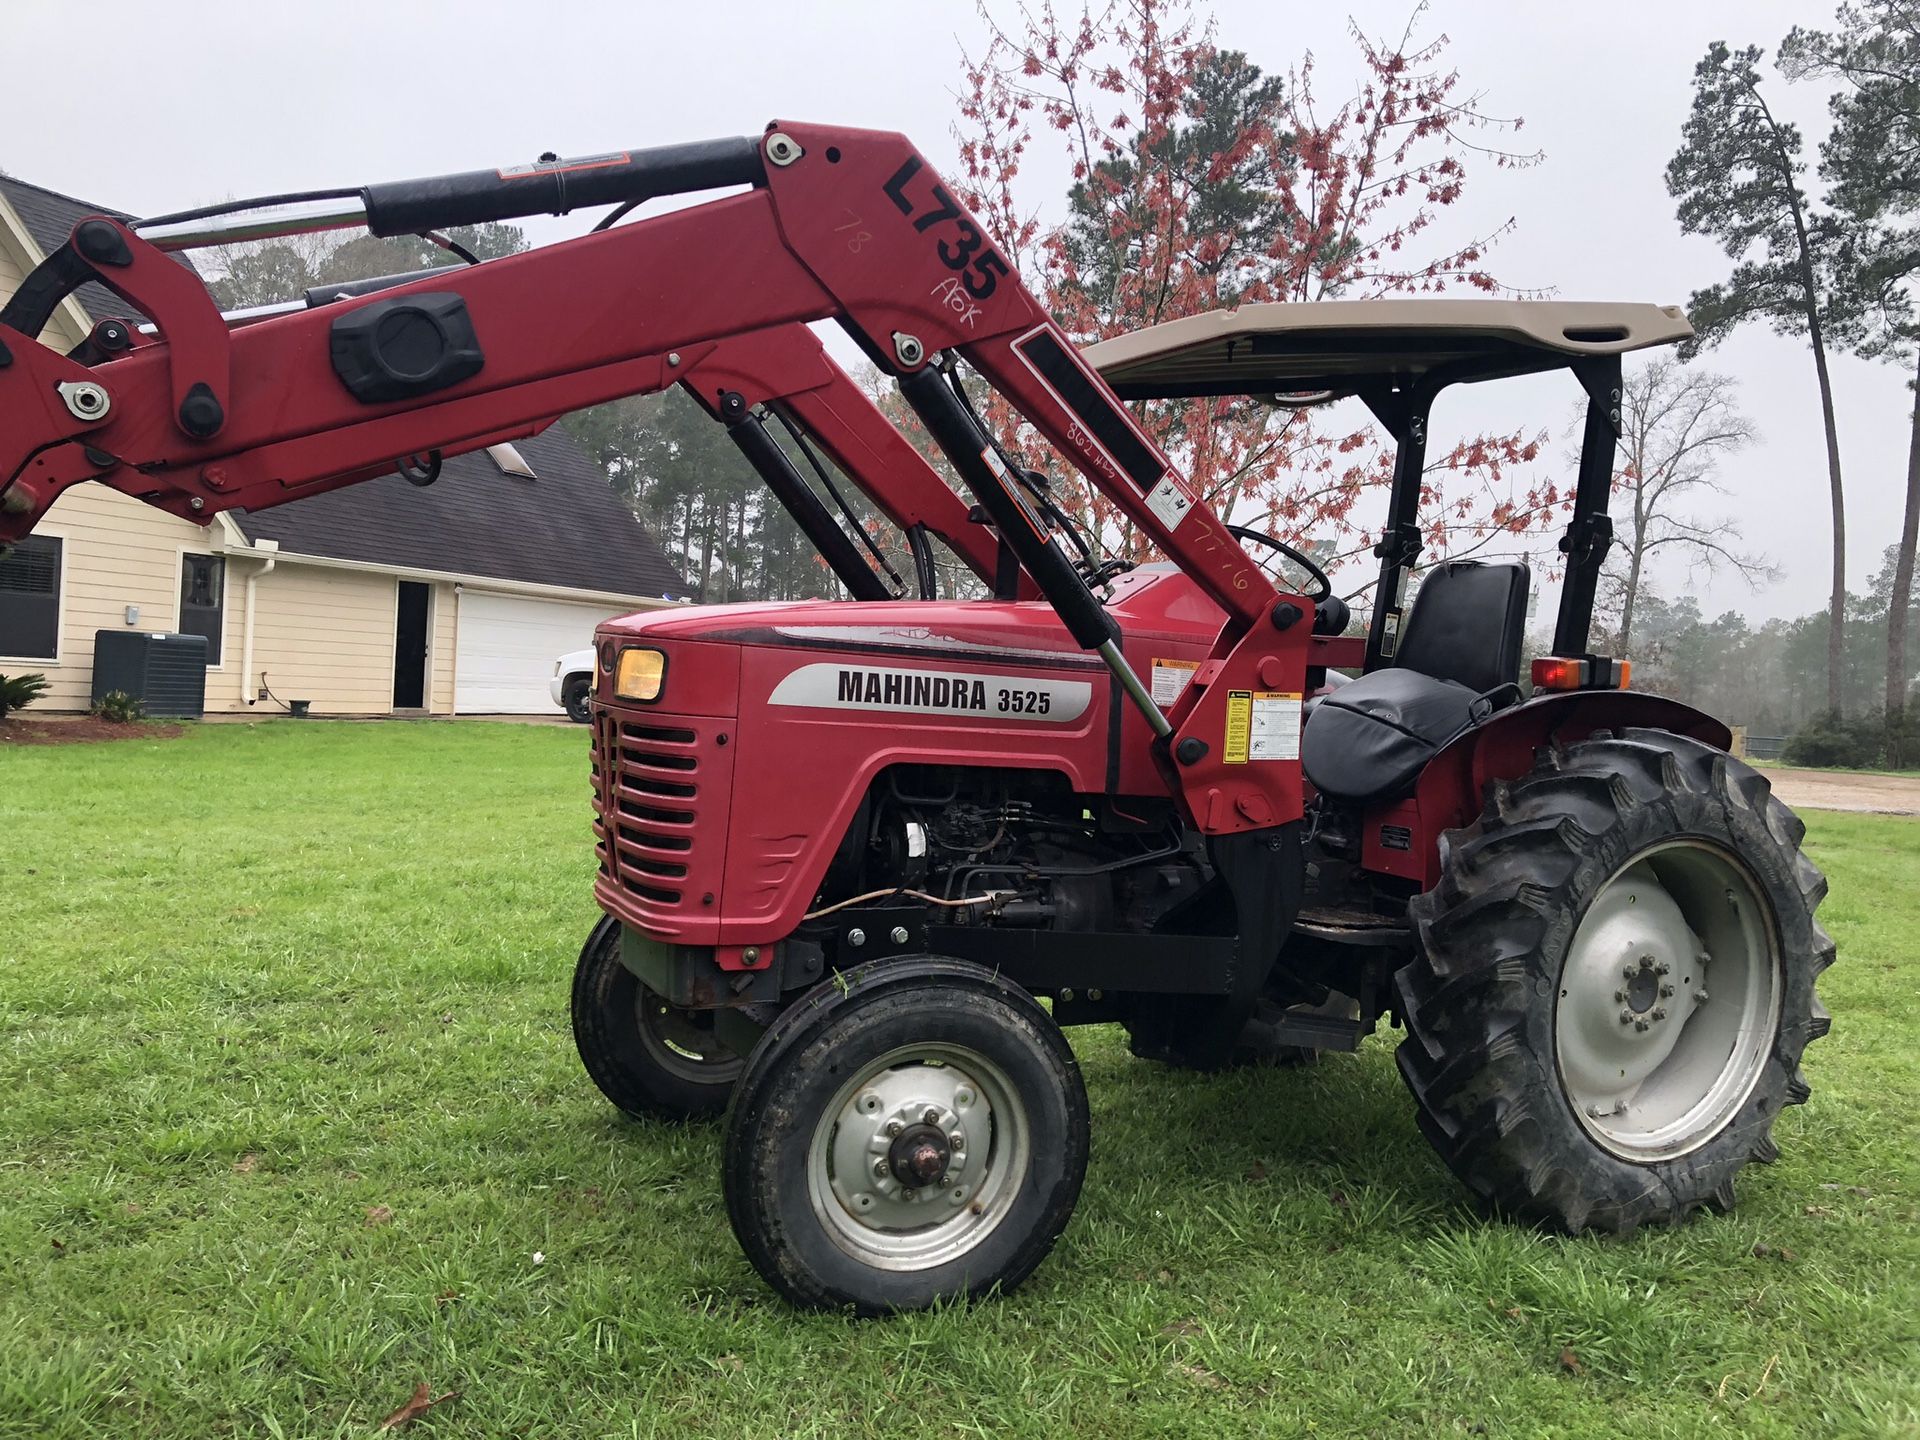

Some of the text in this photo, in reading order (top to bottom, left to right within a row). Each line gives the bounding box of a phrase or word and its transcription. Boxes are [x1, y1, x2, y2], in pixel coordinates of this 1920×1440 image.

[882, 154, 1010, 300] L735
[1067, 422, 1092, 457] 862
[838, 671, 1050, 714] MAHINDRA 3525
